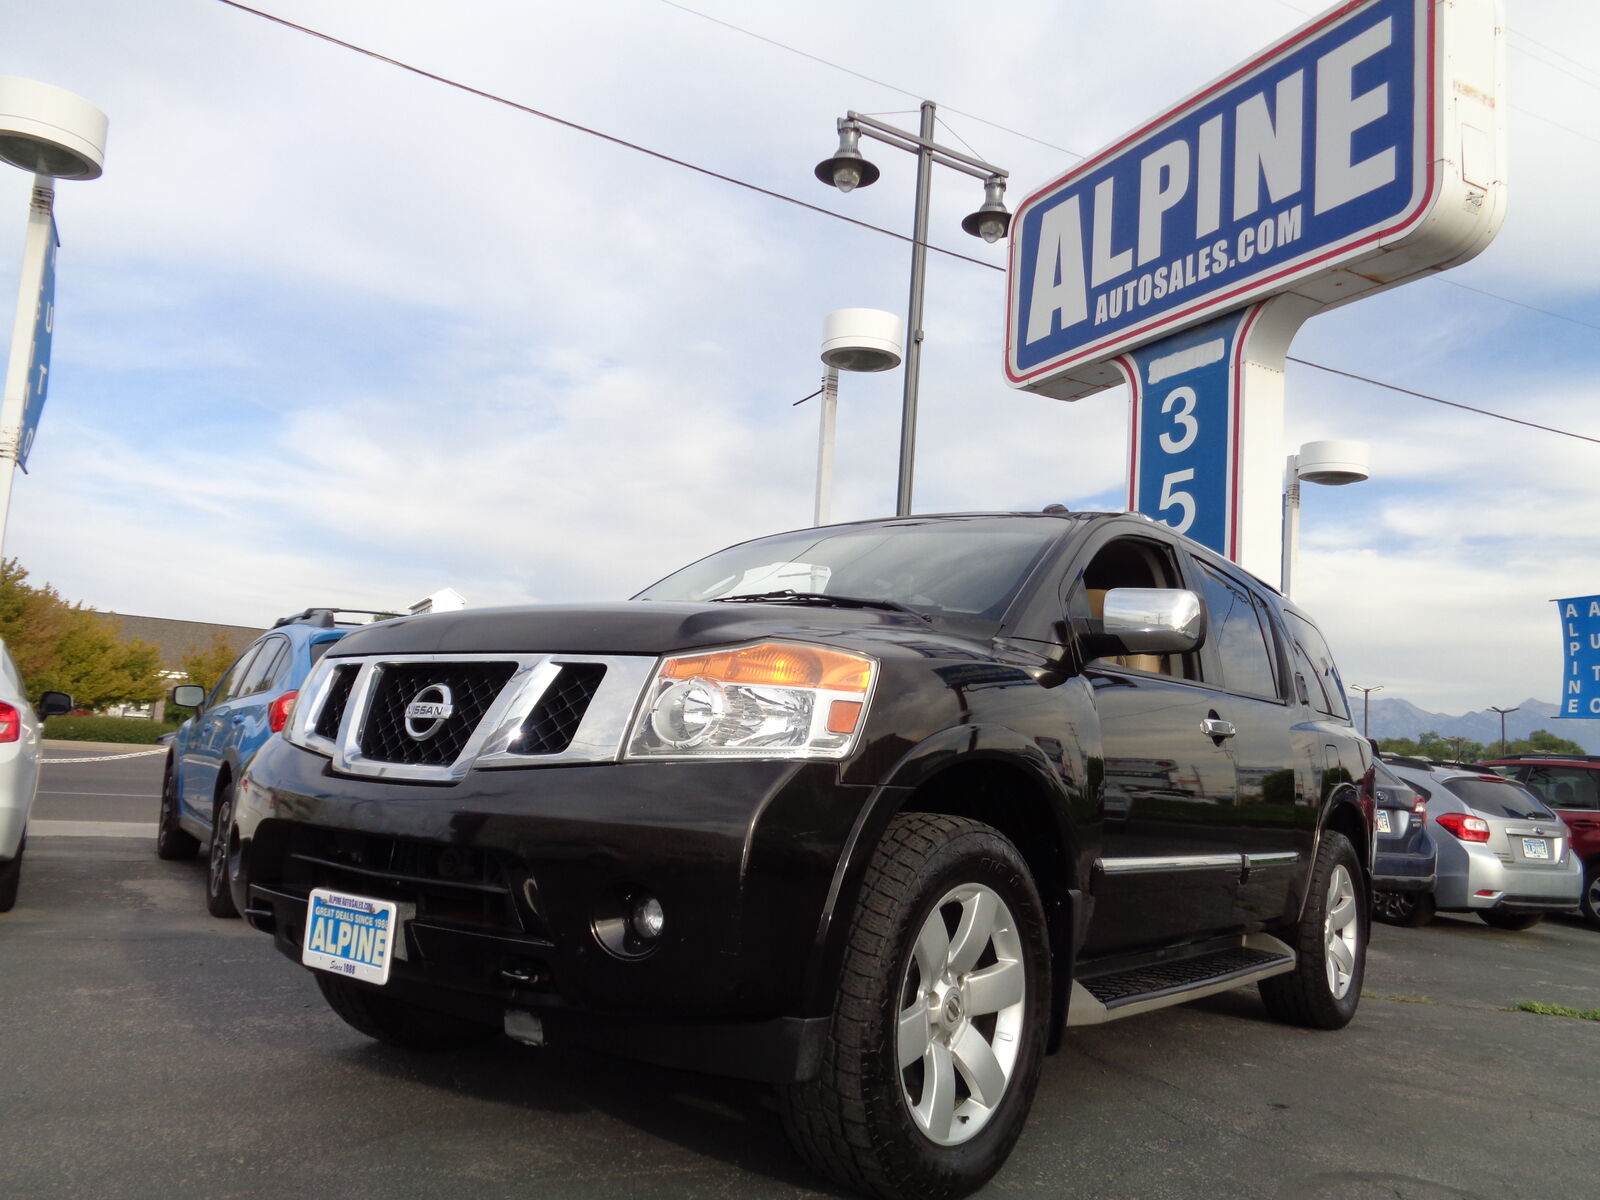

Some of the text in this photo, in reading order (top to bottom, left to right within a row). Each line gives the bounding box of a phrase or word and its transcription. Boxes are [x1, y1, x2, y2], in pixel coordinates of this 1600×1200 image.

[1026, 16, 1396, 345] ALPINE
[1094, 204, 1302, 326] AUTOSALES.COM
[1566, 604, 1581, 713] ALPINE
[408, 705, 443, 716] NISSAN
[310, 917, 387, 964] ALPINE
[335, 909, 354, 922] DEALS
[354, 914, 374, 926] SINCE
